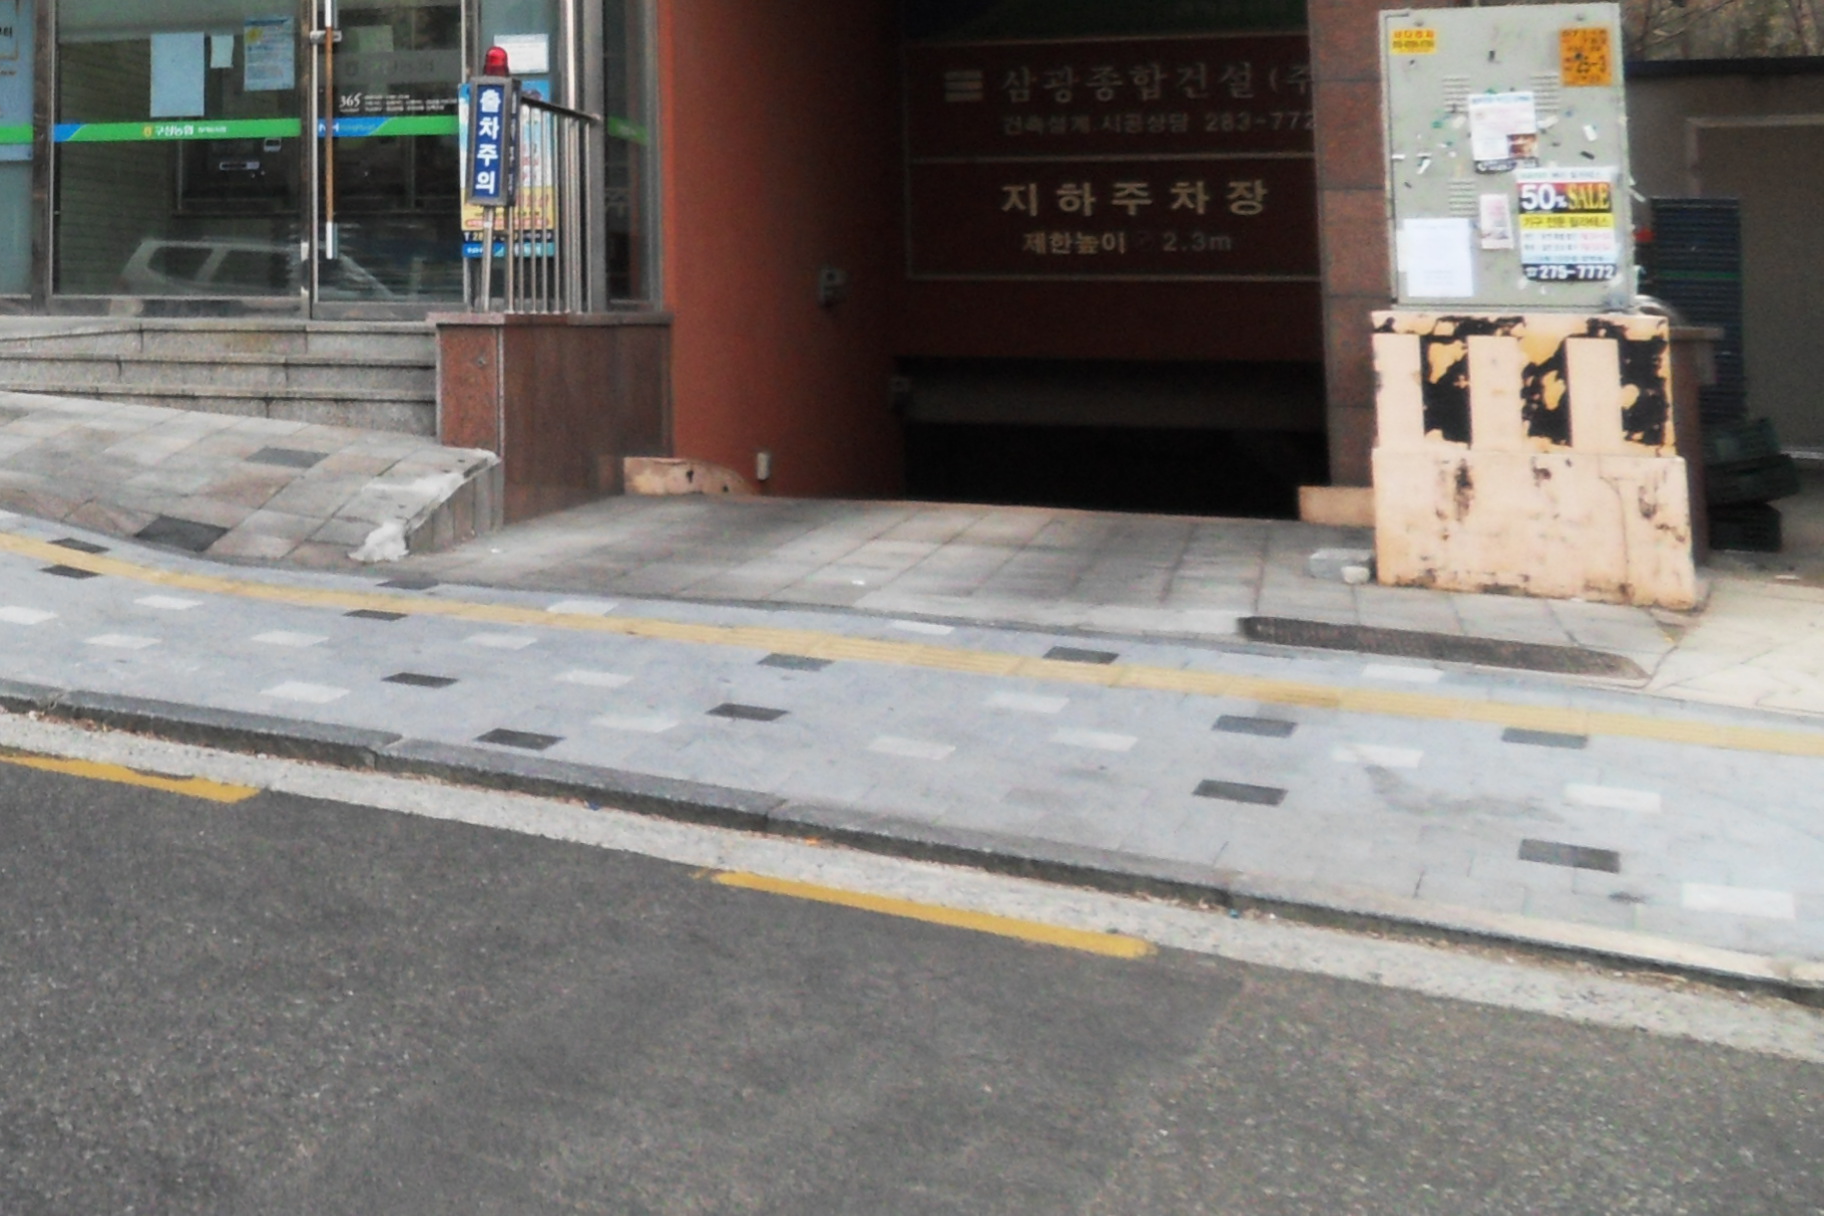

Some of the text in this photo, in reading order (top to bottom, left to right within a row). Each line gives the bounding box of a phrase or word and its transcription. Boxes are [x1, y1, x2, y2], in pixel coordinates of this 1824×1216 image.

[475, 88, 502, 195] 출차주의
[999, 178, 1269, 217] 지하주차장
[1521, 181, 1610, 211] 50% SALE
[1021, 229, 1233, 255] 제한높이 2.3m
[1538, 264, 1615, 280] 275-7772
